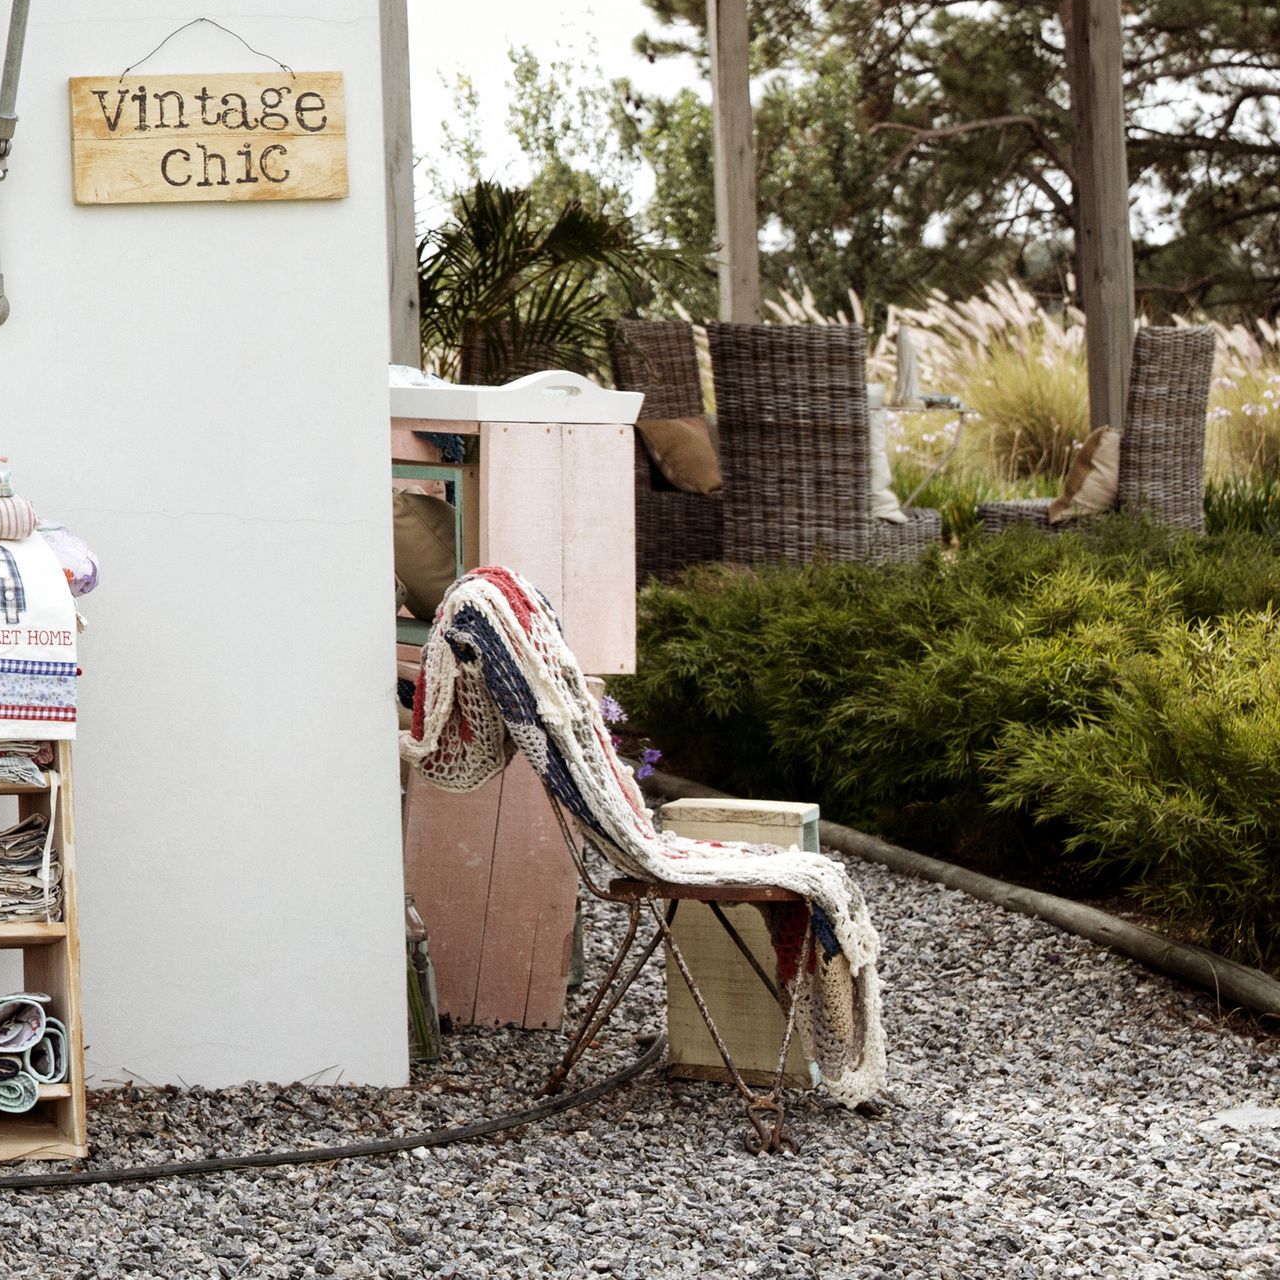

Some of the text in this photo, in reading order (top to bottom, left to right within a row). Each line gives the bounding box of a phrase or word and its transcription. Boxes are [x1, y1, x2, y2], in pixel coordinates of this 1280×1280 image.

[90, 85, 329, 133] vintage
[160, 143, 292, 188] chic
[26, 630, 73, 646] HOME
